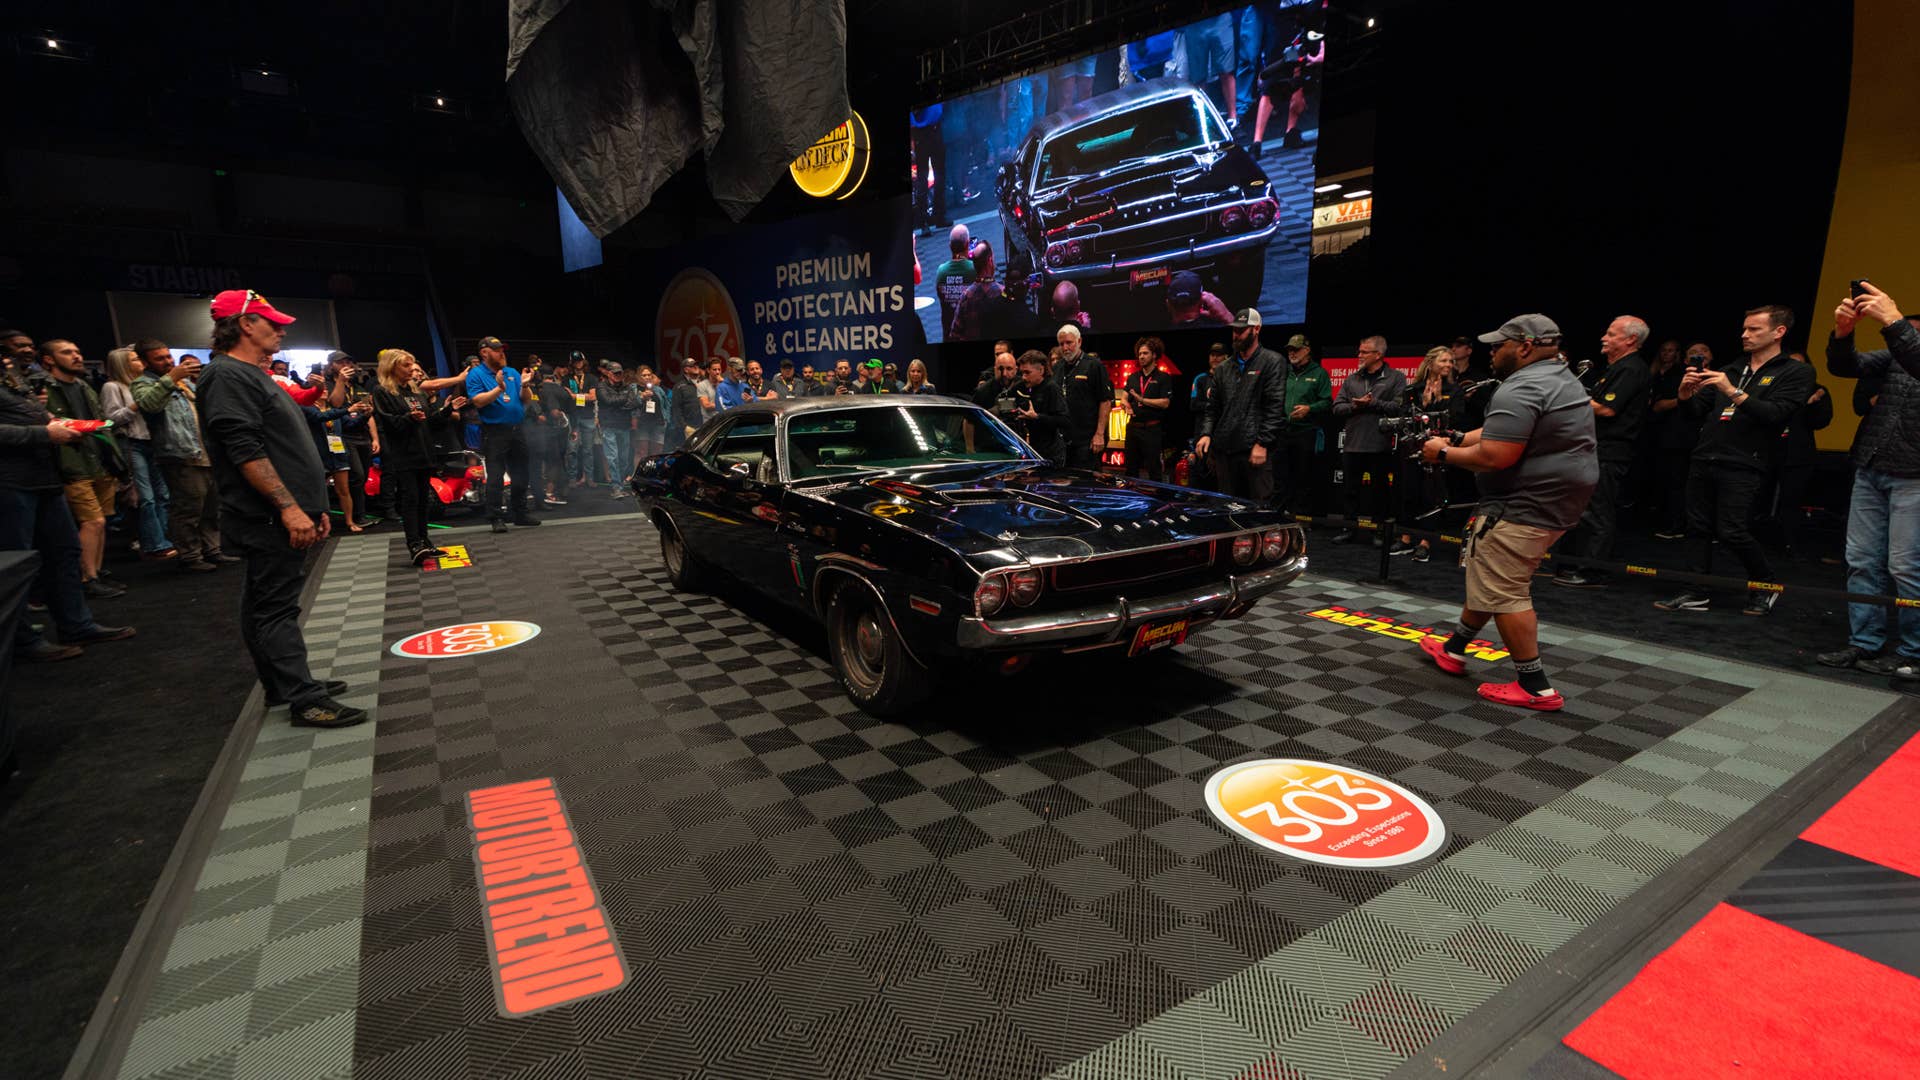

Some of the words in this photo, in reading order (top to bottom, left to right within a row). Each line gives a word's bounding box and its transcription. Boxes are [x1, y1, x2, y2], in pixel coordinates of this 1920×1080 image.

[128, 263, 241, 289] STAGING
[775, 252, 872, 289] PREMIUM
[754, 284, 905, 325] PROTECTANTS
[764, 331, 777, 355] &
[781, 323, 894, 354] CLEANERS
[1626, 565, 1657, 575] MECUM
[1747, 581, 1784, 592] MECUM
[1142, 621, 1186, 643] MECUM
[1237, 774, 1393, 843] 303
[1327, 829, 1370, 853] Exceeding
[1365, 810, 1413, 835] Expectations
[1362, 834, 1388, 848] Since
[1384, 825, 1405, 838] 1980
[469, 777, 625, 1014] MOTORTREND
